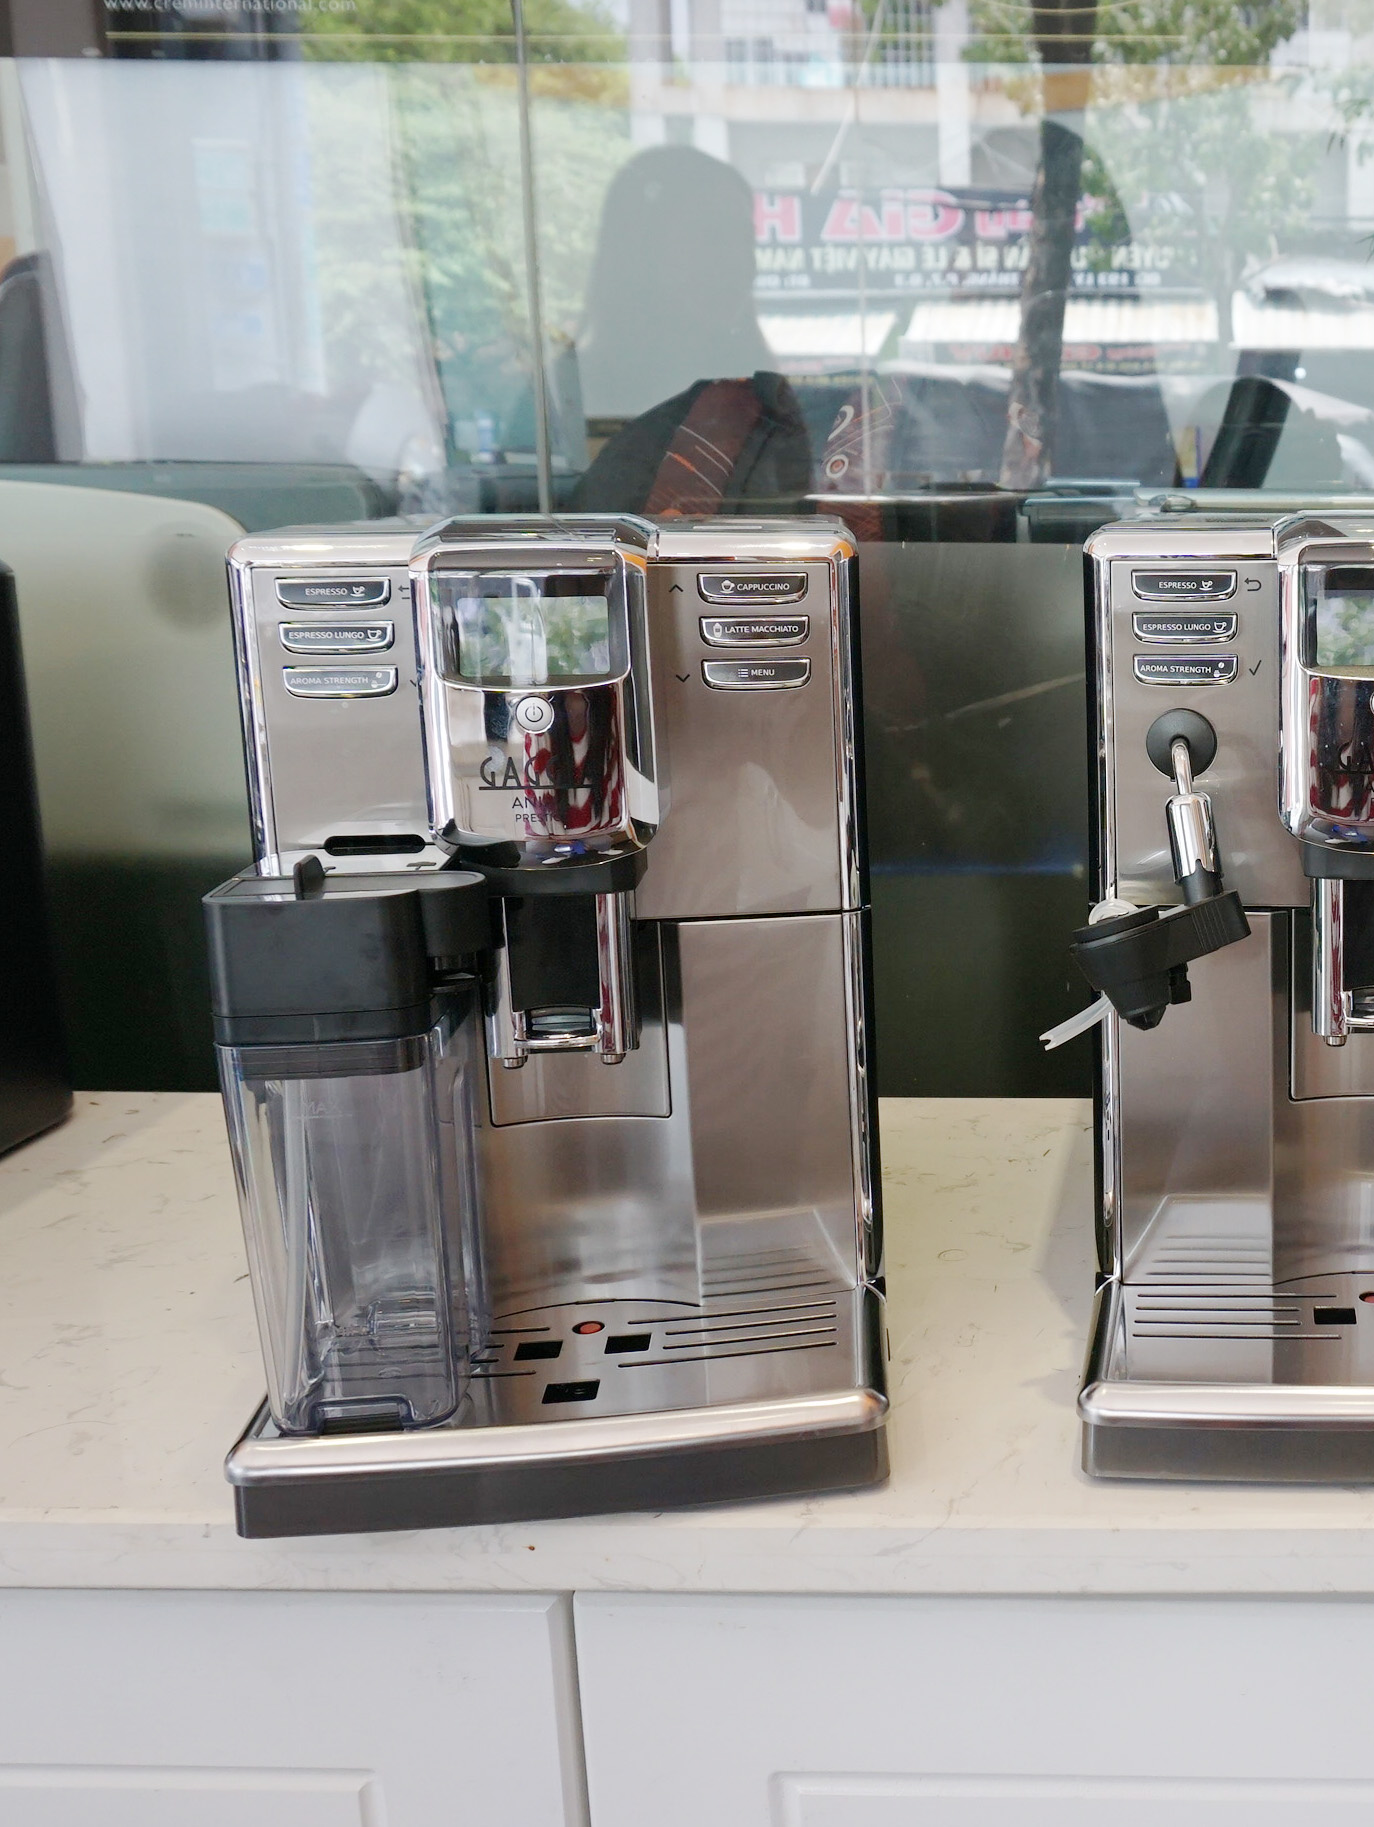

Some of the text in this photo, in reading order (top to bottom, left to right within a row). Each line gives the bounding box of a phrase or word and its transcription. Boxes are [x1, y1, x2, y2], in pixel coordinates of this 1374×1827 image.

[305, 587, 348, 596] ESPRESSO
[737, 583, 790, 591] CAPPUCCINO
[724, 625, 799, 634] LATTE MACCHIATO
[288, 631, 365, 639] ESPRESSO LUNGO
[1169, 665, 1212, 673] STRENGTH
[290, 676, 369, 686] AROMA STRENGTH
[479, 756, 597, 790] GAGG
